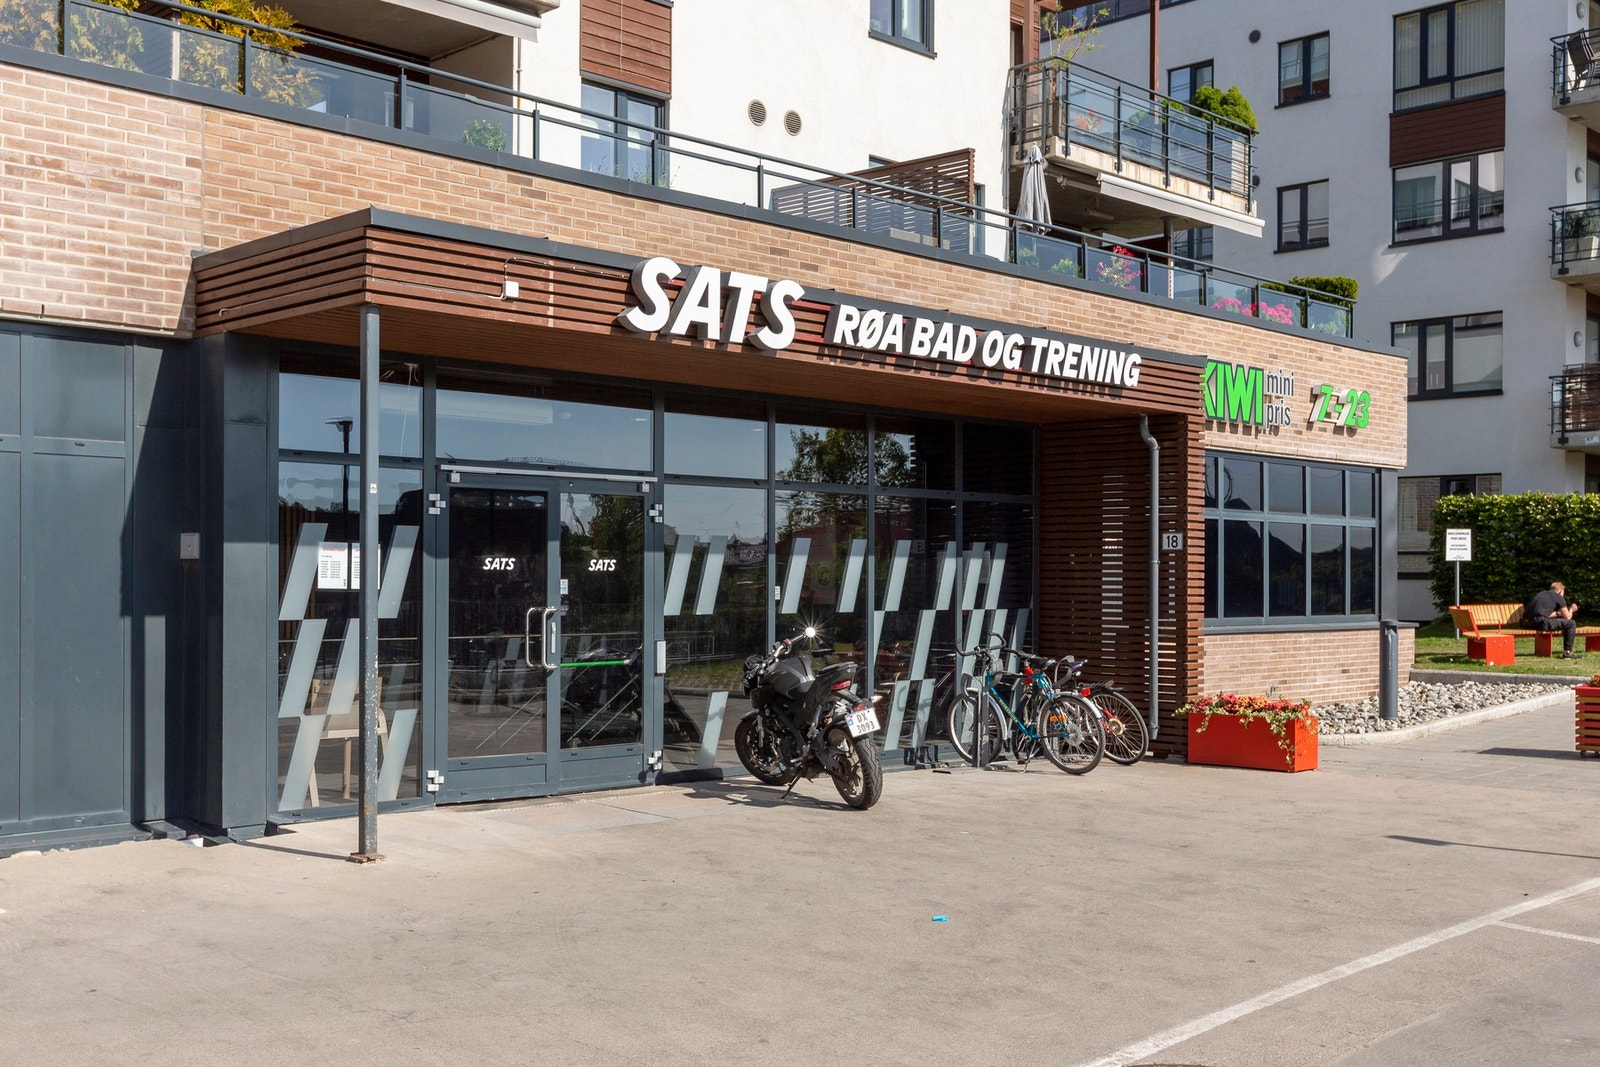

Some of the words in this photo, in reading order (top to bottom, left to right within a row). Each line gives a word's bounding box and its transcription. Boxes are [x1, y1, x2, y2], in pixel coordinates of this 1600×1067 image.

[623, 257, 805, 349] SATS
[833, 304, 903, 353] RØA
[909, 317, 977, 363] BAD
[982, 330, 1025, 370] OG
[1030, 337, 1142, 387] TRENING
[1204, 360, 1264, 426] KIWI
[1266, 370, 1294, 397] mini
[1317, 383, 1371, 429] 7-23
[1266, 400, 1291, 428] pris
[1166, 535, 1179, 548] 18
[482, 557, 516, 571] SATS
[588, 559, 617, 572] SATS
[856, 713, 868, 722] DX
[856, 721, 875, 733] 3093
